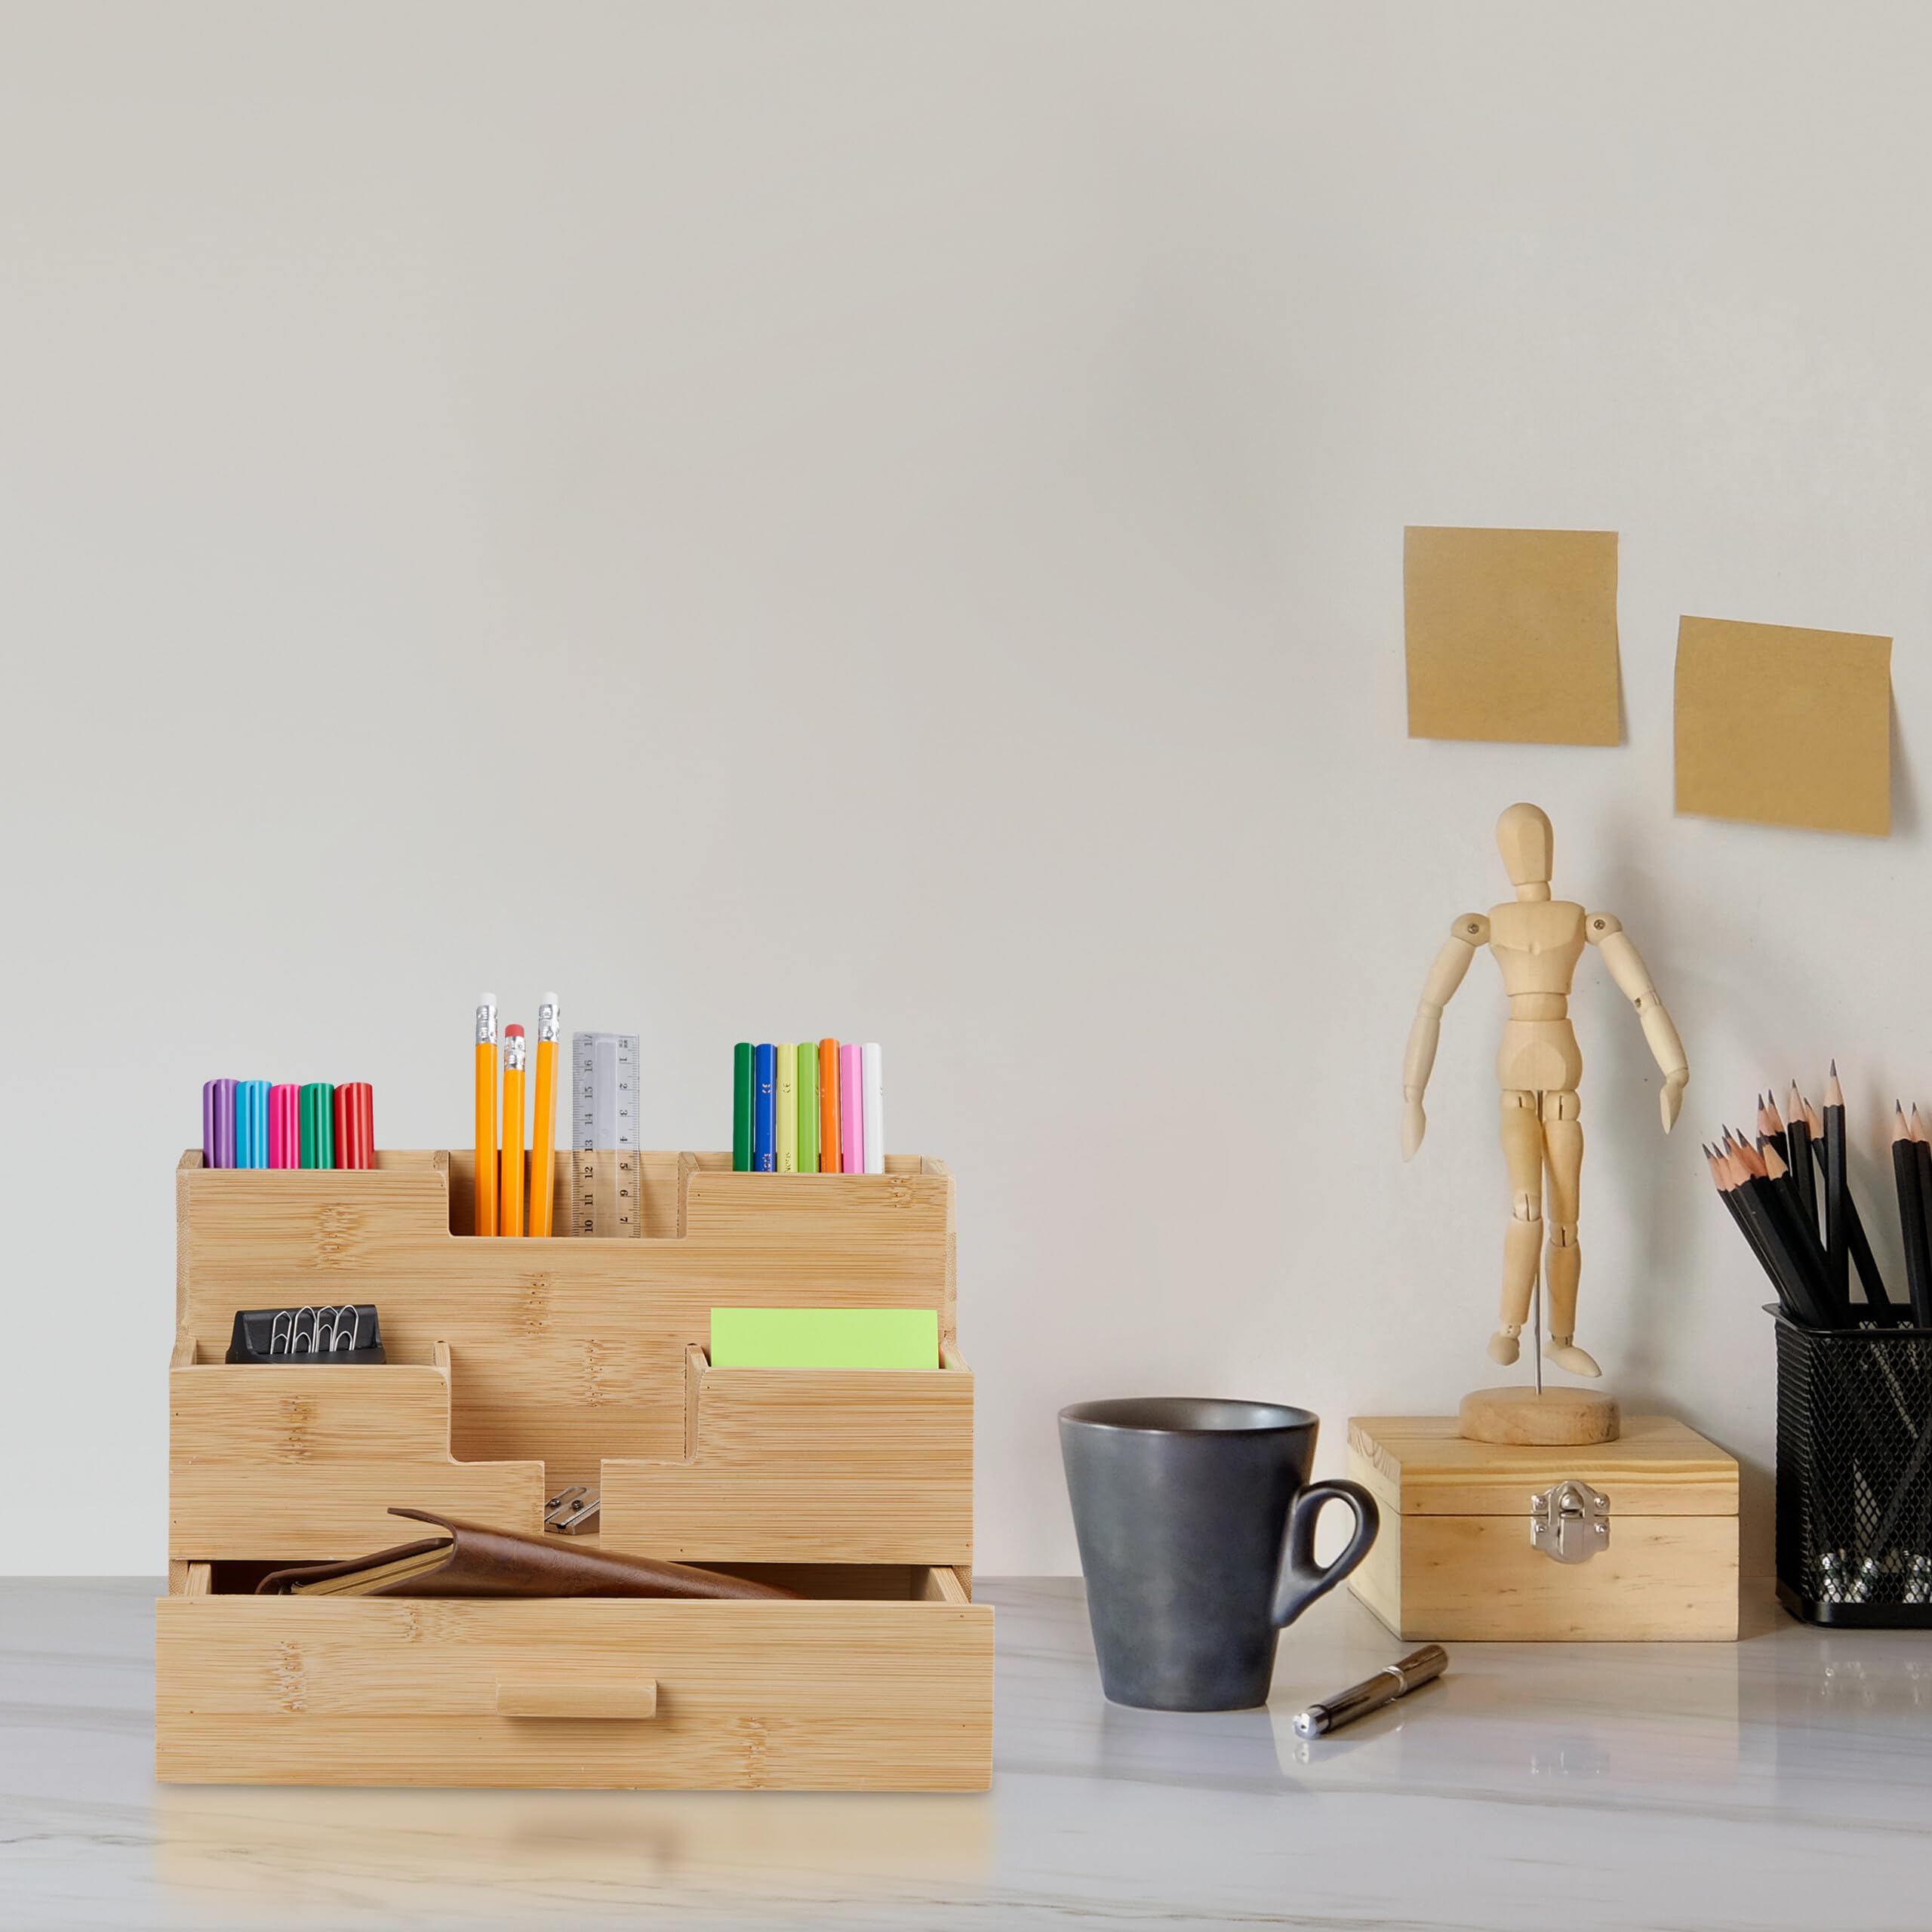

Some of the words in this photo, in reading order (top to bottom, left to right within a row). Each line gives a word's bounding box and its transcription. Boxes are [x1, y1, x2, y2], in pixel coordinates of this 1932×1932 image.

[584, 1034, 592, 1047] 17
[584, 1060, 592, 1072] 16
[584, 1087, 592, 1099] 15
[584, 1113, 592, 1125] 14
[584, 1140, 593, 1152] 13
[584, 1166, 593, 1179] 12
[584, 1193, 593, 1206] 11
[584, 1220, 593, 1232] 10
